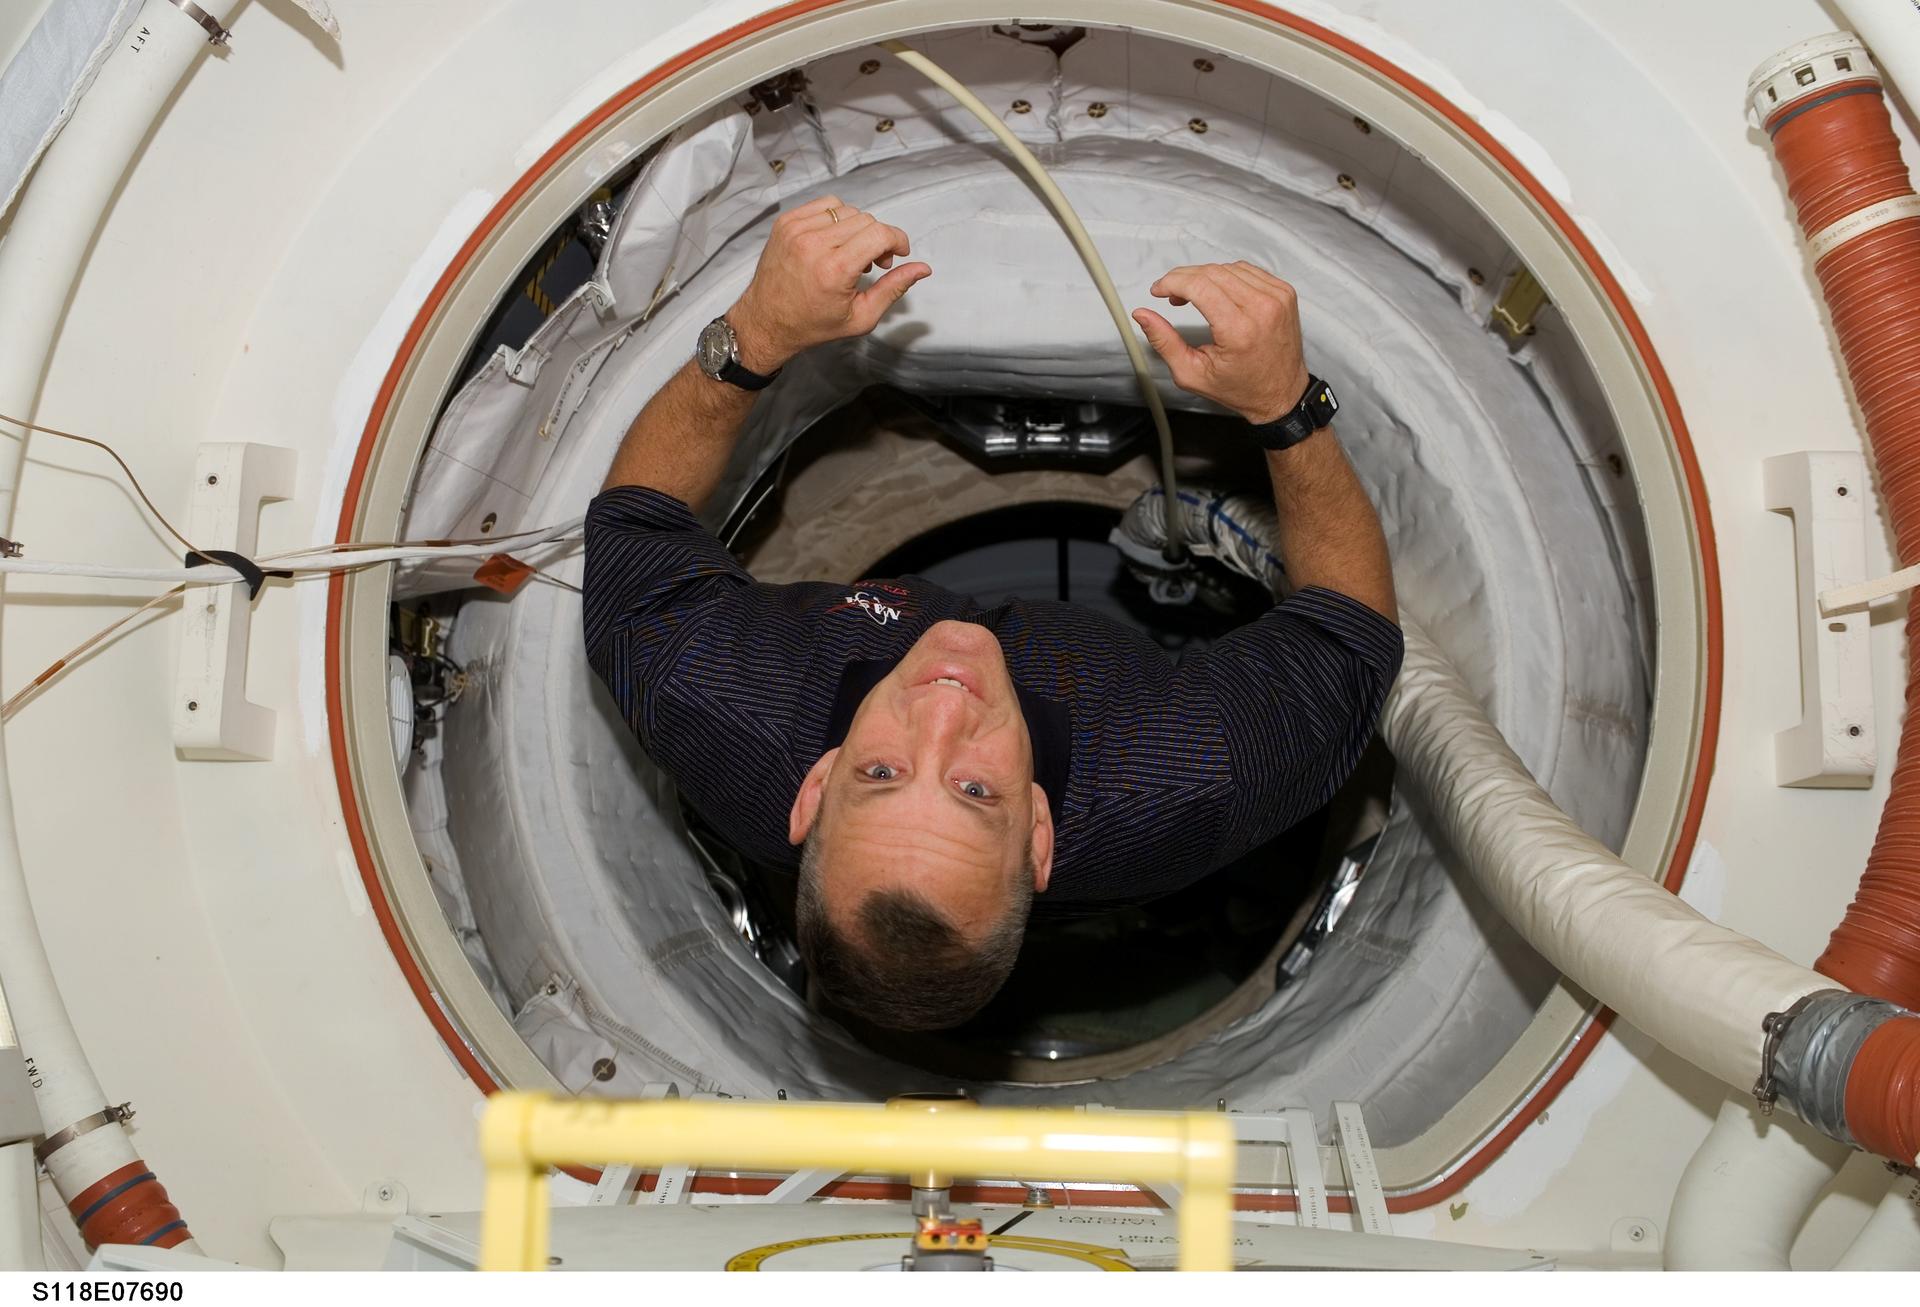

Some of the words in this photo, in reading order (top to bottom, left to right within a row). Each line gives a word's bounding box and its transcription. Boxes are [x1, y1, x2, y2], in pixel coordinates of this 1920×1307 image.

[130, 26, 151, 54] AFT
[845, 591, 902, 625] NASA
[24, 1057, 43, 1089] FWD
